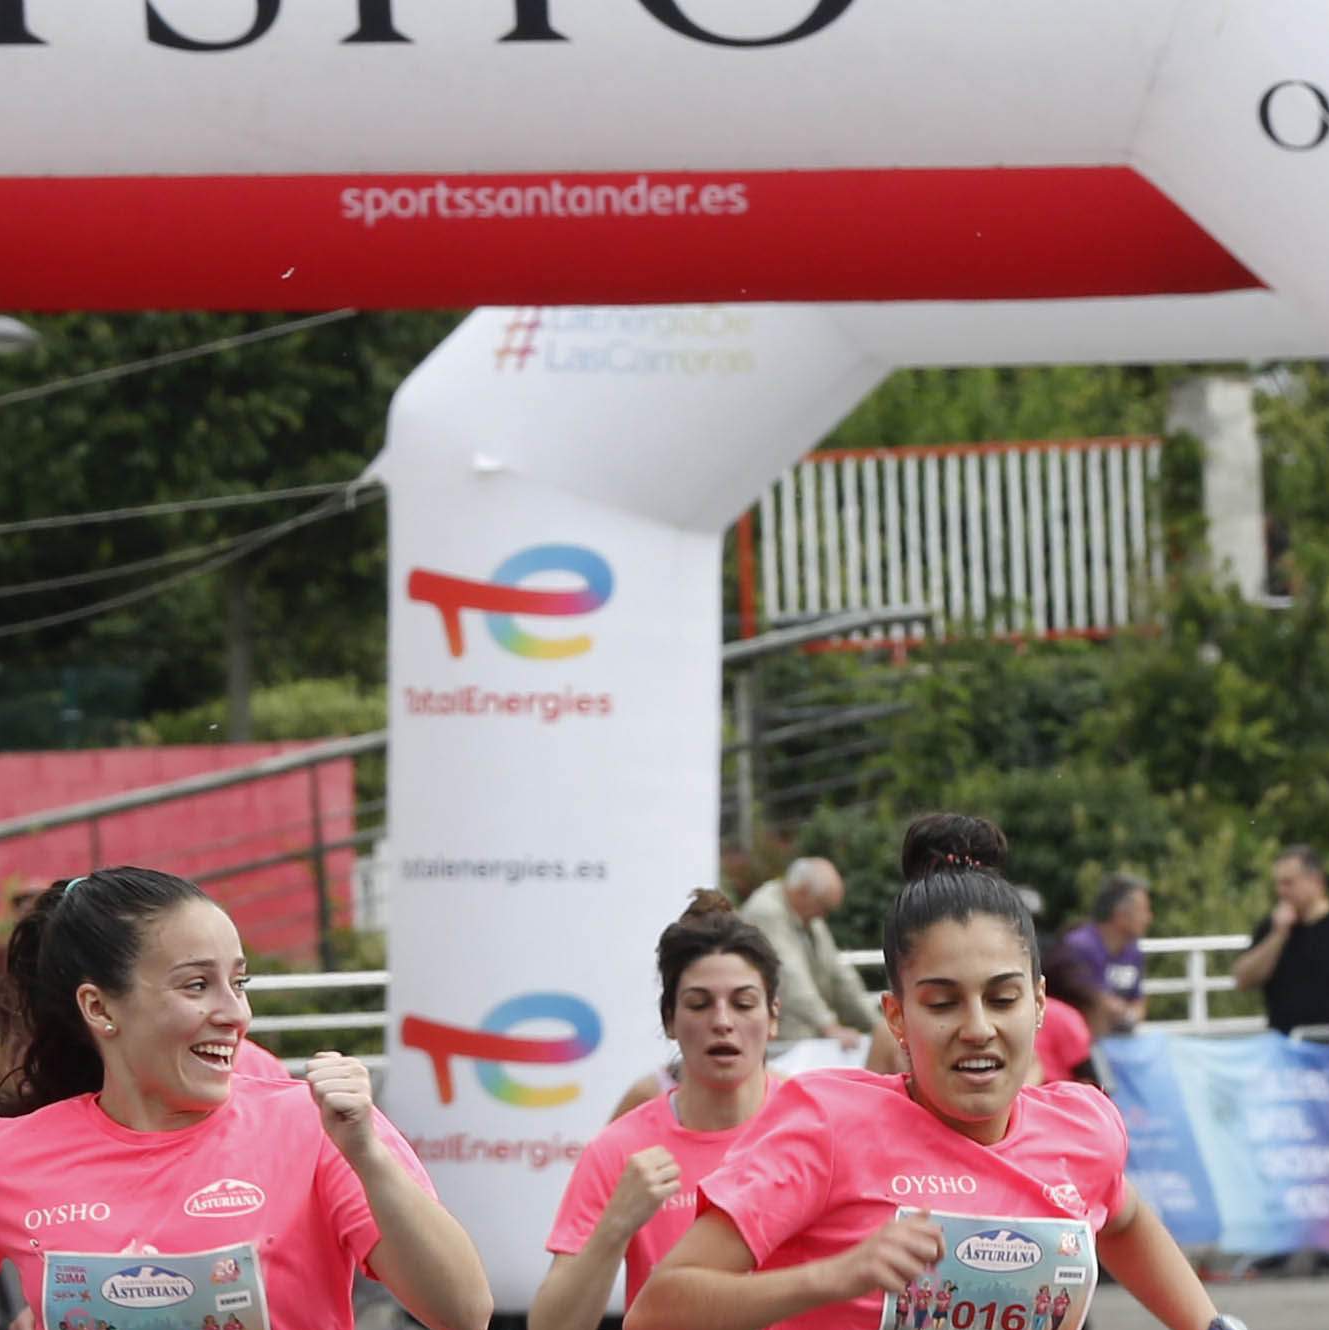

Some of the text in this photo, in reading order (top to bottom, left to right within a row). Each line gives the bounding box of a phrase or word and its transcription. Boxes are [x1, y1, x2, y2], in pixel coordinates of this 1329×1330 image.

[340, 174, 749, 227] sportssantander.es
[891, 1174, 978, 1195] OYSHO
[24, 1202, 110, 1230] OYSHO
[962, 1242, 1036, 1264] ASTURIANA
[108, 1281, 190, 1299] ASTURIANA
